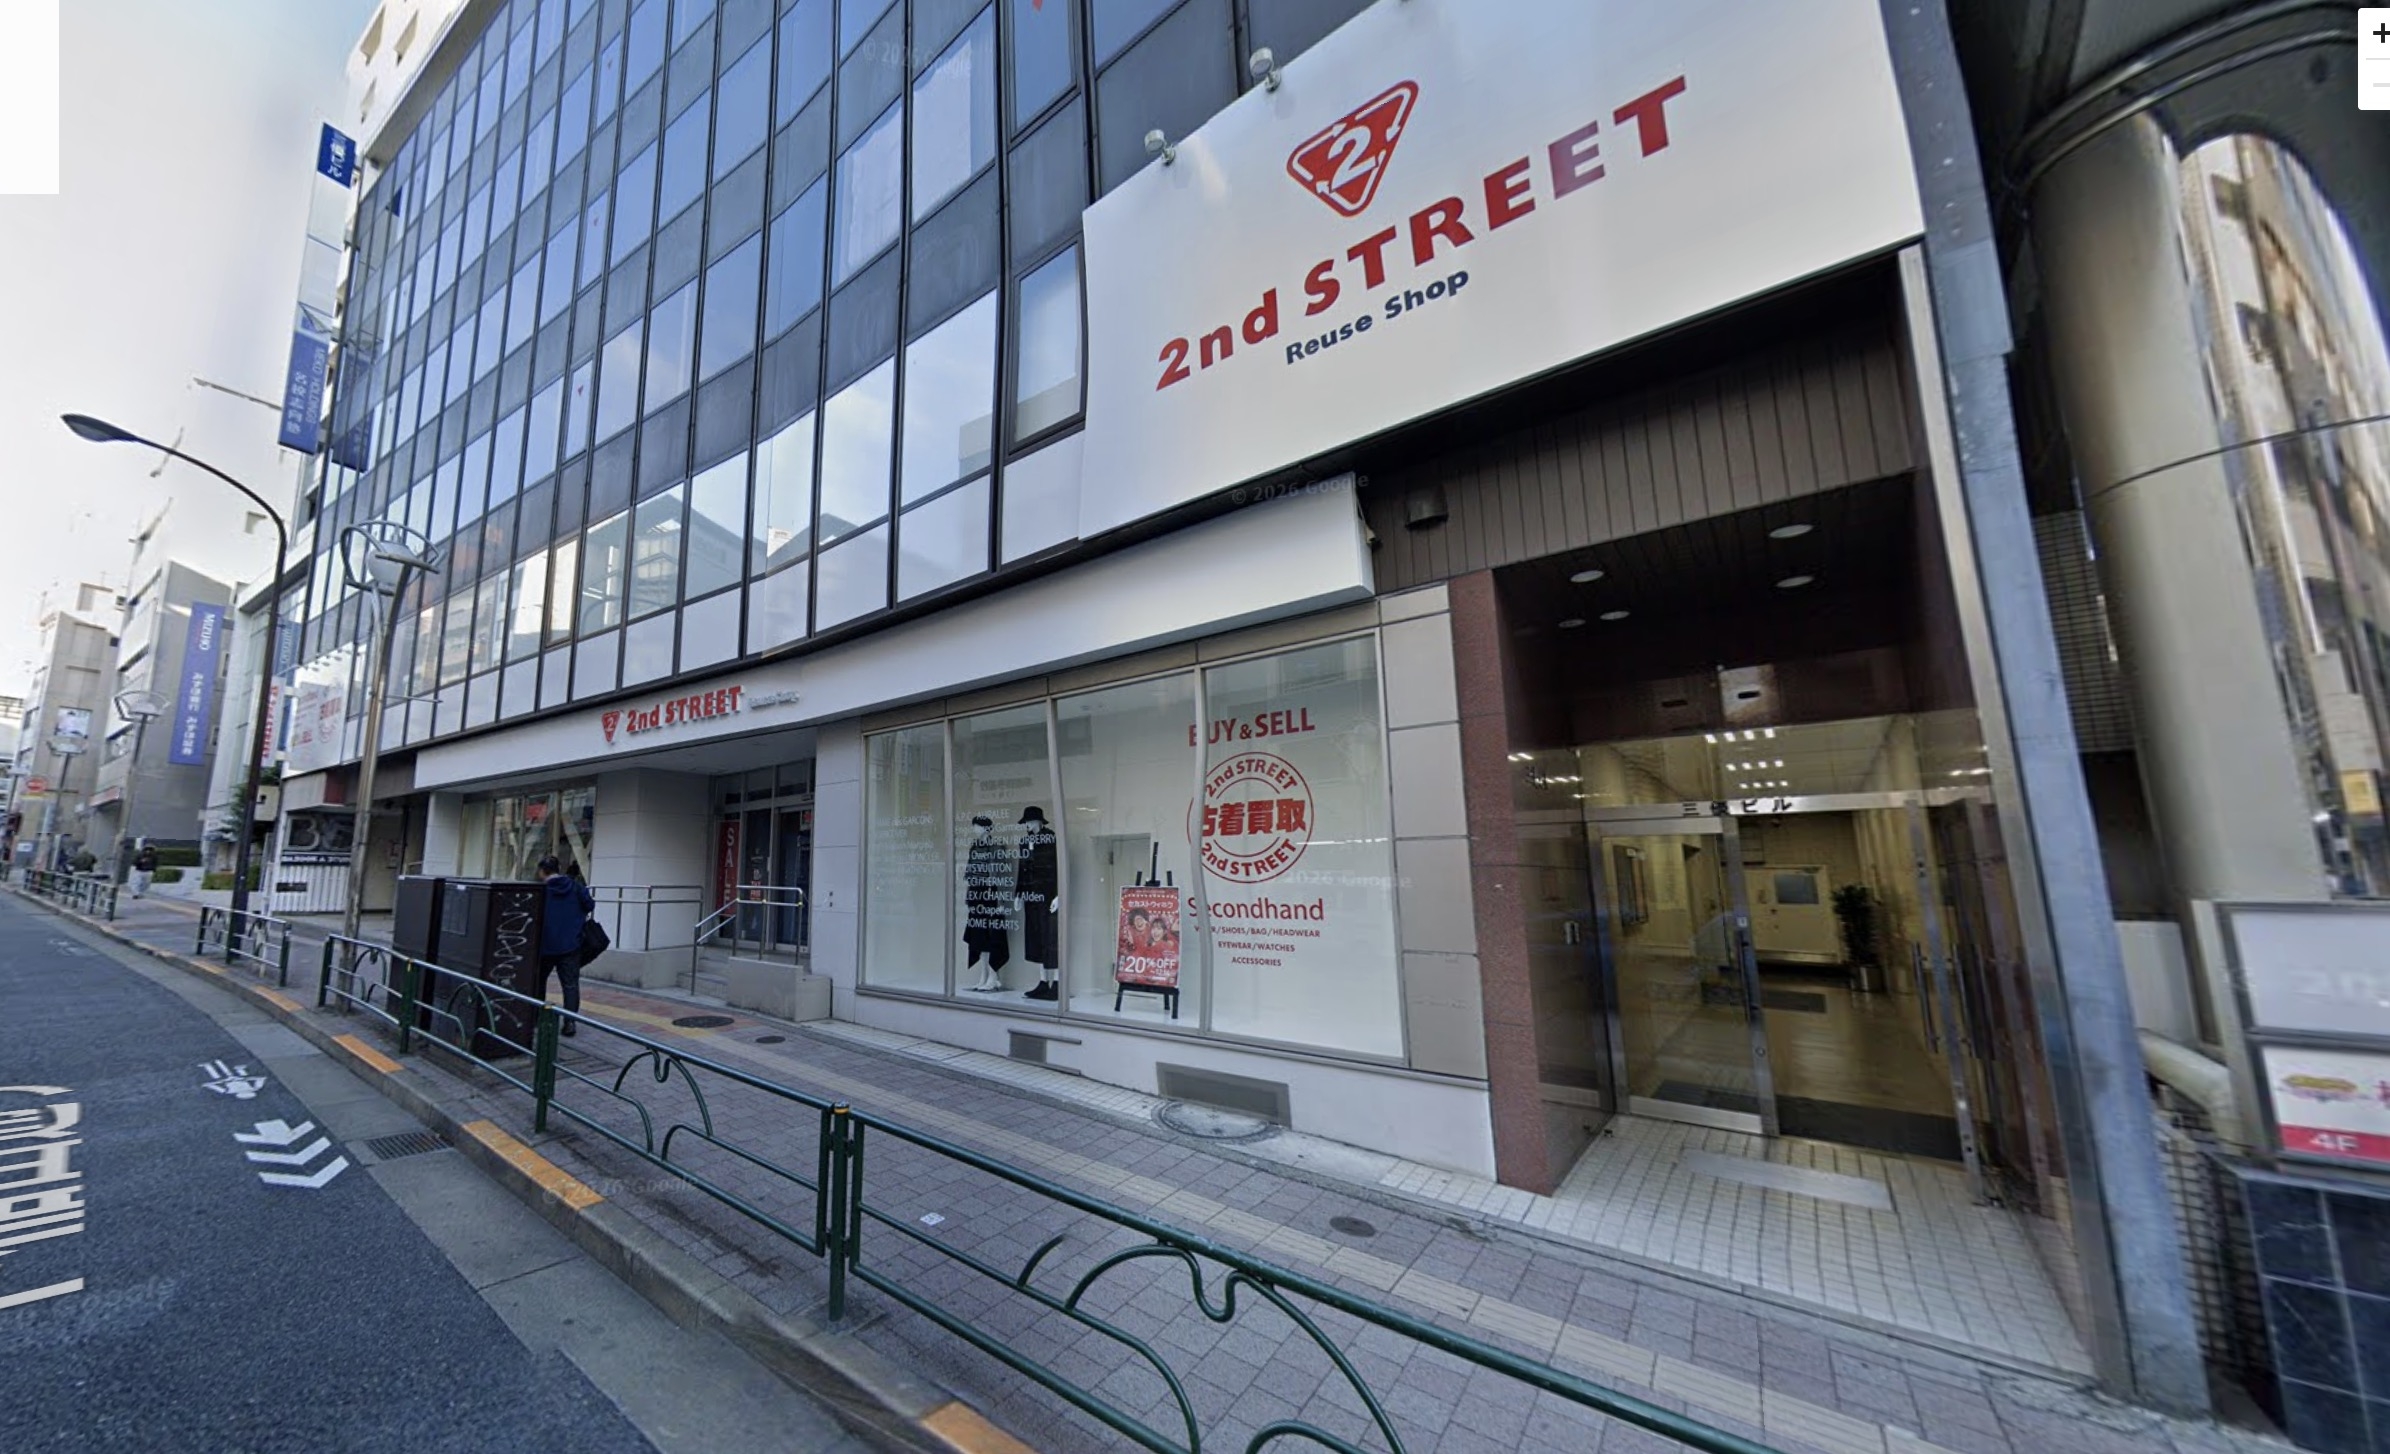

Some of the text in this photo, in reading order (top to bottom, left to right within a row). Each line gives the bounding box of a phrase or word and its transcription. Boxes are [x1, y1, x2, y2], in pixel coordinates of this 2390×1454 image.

[1155, 74, 1689, 391] 2nd STREET
[1284, 269, 1470, 366] Reuse Shop
[626, 704, 660, 733] 2nd
[665, 685, 742, 724] STREET
[1239, 723, 1252, 740] &
[1255, 707, 1315, 738] SELL
[1206, 758, 1298, 797] 2nd STREET
[1201, 838, 1298, 877] 2nd STREET
[988, 918, 1020, 931] HEARTS
[1231, 956, 1282, 967] ACCESSORIES
[2308, 1132, 2359, 1152] 4F
